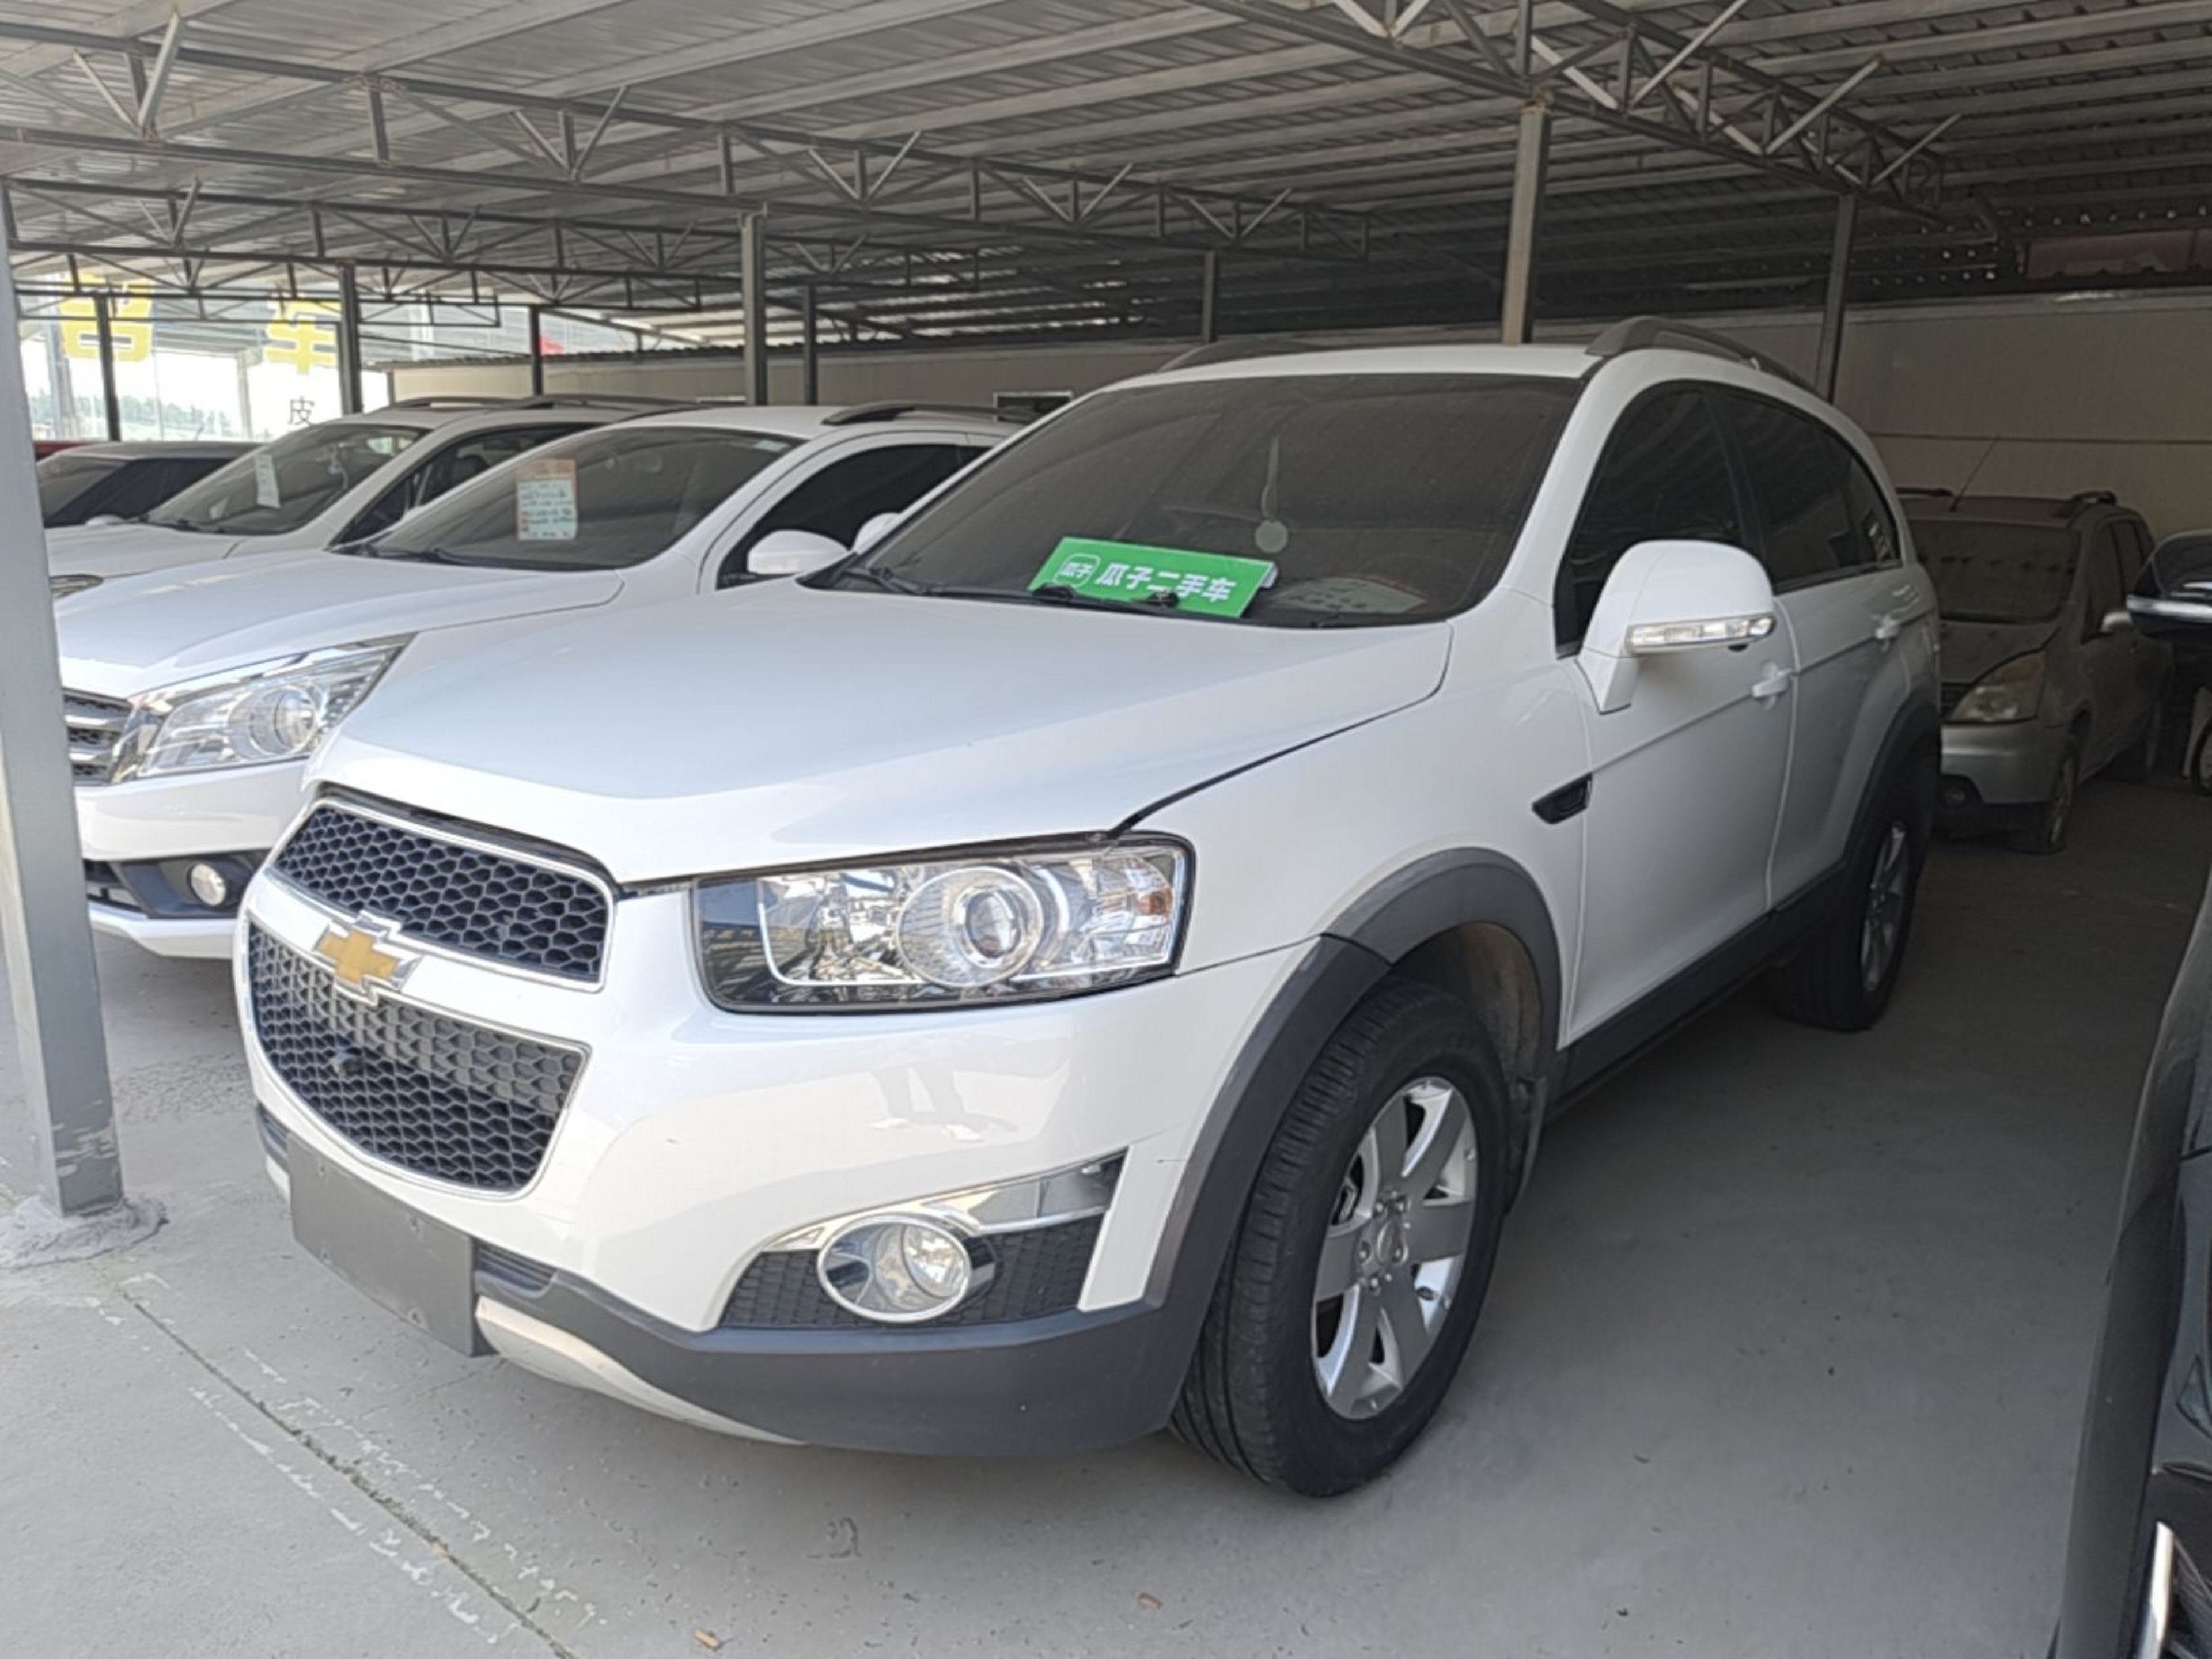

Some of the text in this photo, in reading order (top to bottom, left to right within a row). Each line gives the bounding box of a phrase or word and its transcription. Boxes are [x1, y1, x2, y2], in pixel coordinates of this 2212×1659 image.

[1096, 562, 1236, 602] 瓜子二手车
